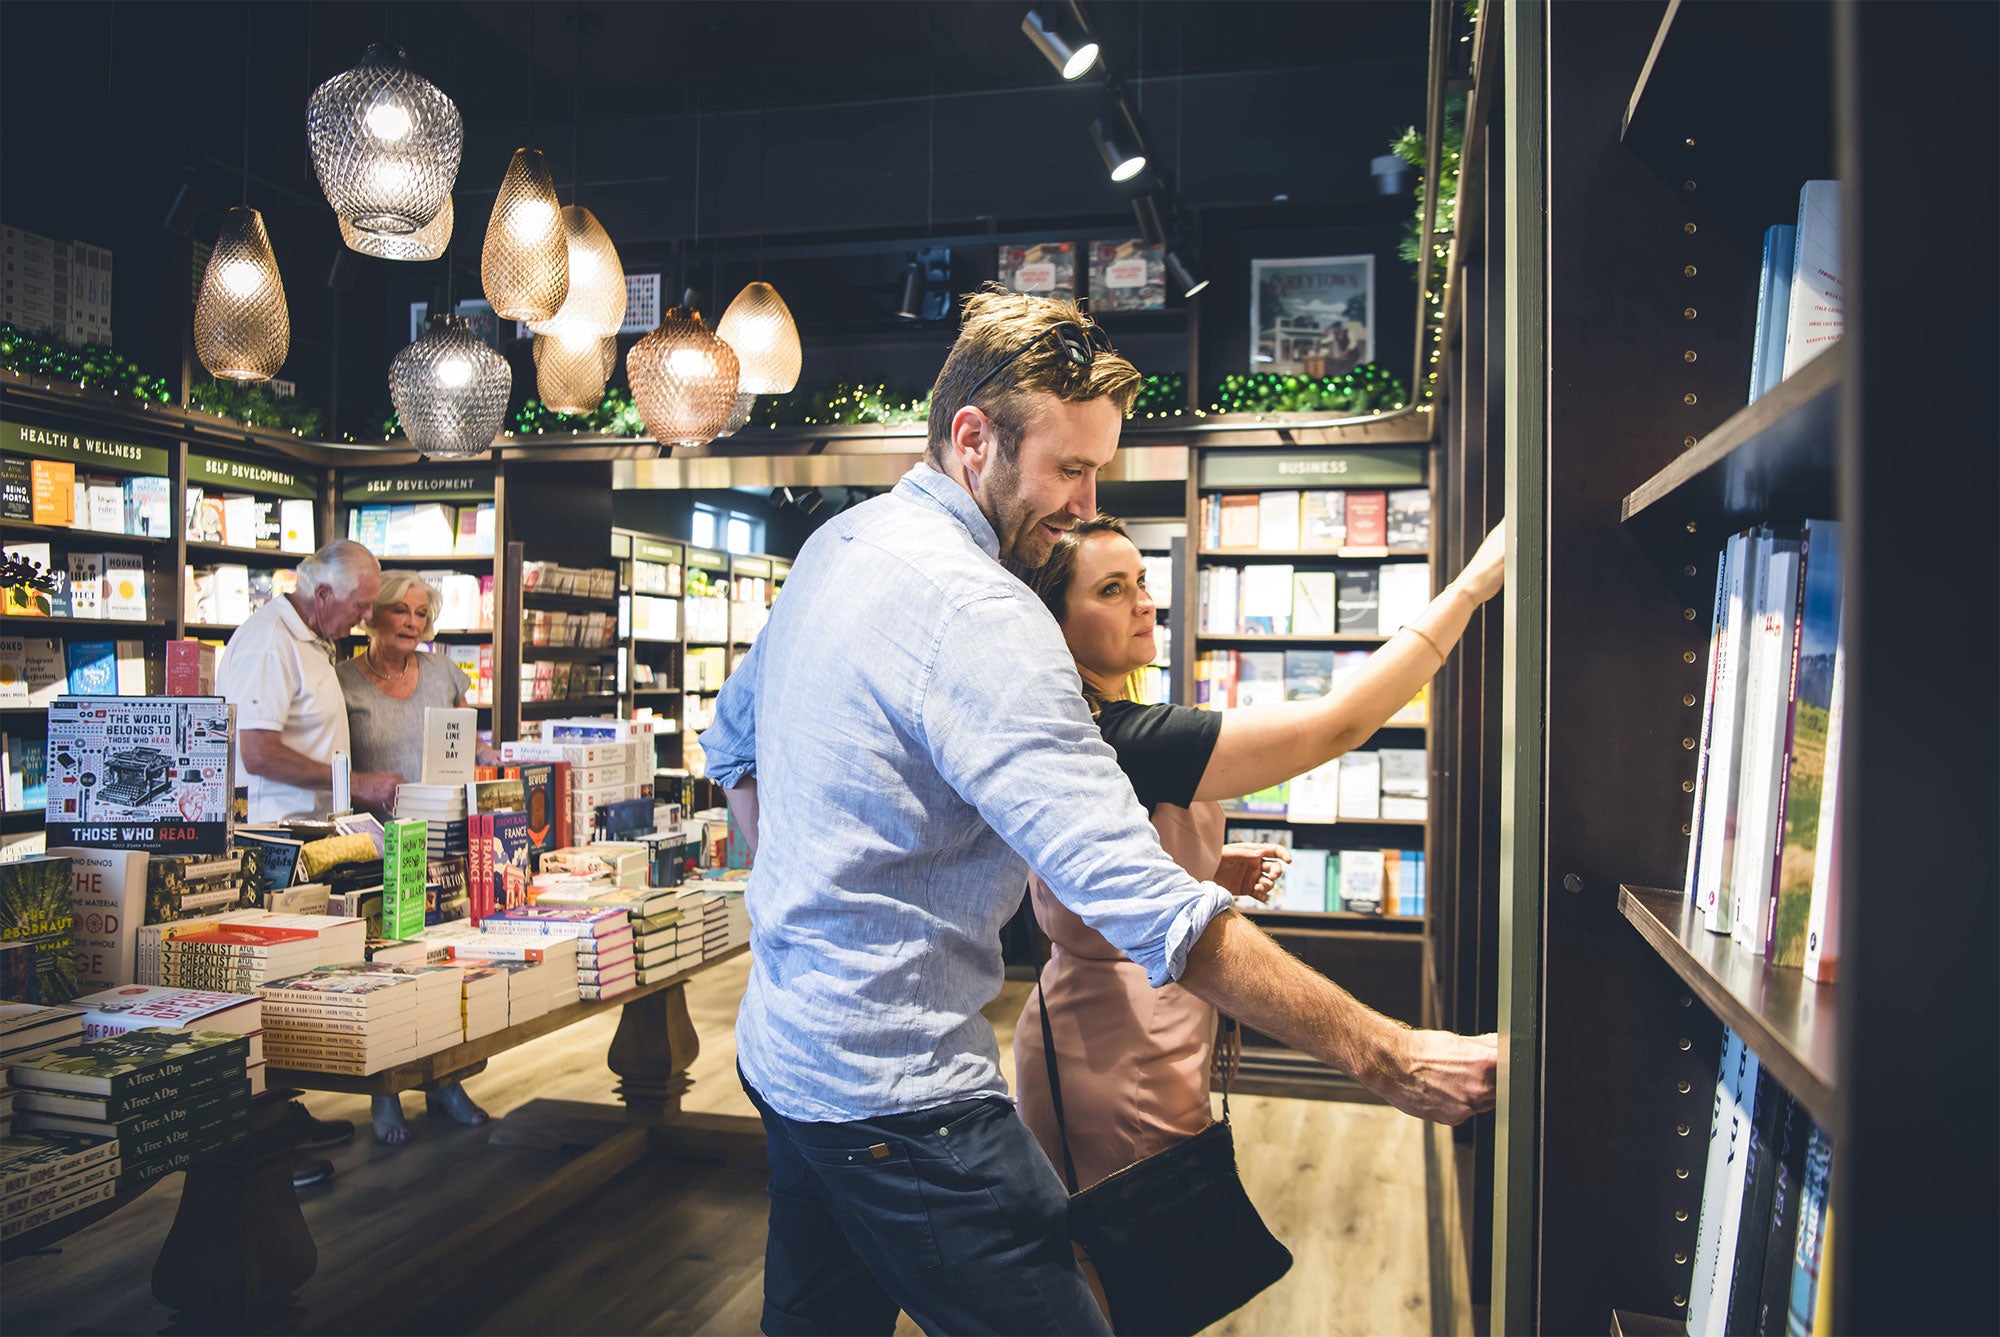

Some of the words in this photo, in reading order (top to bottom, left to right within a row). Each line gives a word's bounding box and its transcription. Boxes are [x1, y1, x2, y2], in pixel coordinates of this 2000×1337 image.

[20, 427, 68, 448] HEALTH
[72, 437, 81, 450] &
[86, 439, 142, 460] WELLNESS
[205, 460, 229, 475] SELF
[231, 464, 294, 486] DEVELOPMENT
[1278, 460, 1348, 474] BUSINESS
[5, 484, 27, 495] BEING
[367, 480, 393, 492] SELF
[396, 478, 475, 491] DEVELOPMENT
[2, 492, 31, 504] MORTAL
[109, 557, 143, 569] HOOKED
[109, 714, 130, 724] THE
[133, 714, 171, 724] WORLD
[106, 725, 154, 735] BELONGS
[157, 725, 171, 735] TO
[446, 722, 460, 731] ONE
[108, 736, 130, 744] THOSE
[133, 736, 149, 744] WHO
[445, 732, 460, 740] LINE
[450, 741, 455, 750] A
[445, 751, 458, 759] DAY
[528, 773, 548, 786] SEWERS
[72, 828, 118, 841] THOSE
[121, 828, 154, 841] WHO
[159, 828, 199, 840] READ.
[504, 826, 527, 839] FRANCE
[402, 840, 417, 852] HOW
[419, 838, 425, 851] TO
[87, 859, 113, 867] ENNOS
[402, 854, 420, 869] SPEND
[470, 838, 480, 882] FRANCE
[483, 838, 493, 883] FRANCE
[402, 871, 424, 885] TRILLION
[84, 900, 118, 908] MATERIAL
[3, 917, 73, 940] RBORNAUT
[73, 913, 119, 934] OOD
[91, 940, 115, 949] WHOLE
[181, 942, 233, 956] CHECKLIST
[239, 945, 254, 953] ATUL
[75, 954, 103, 974] GE
[179, 954, 231, 968] CHECKLIST
[237, 957, 253, 965] ATUL
[179, 966, 230, 979] CHECKLIST
[236, 969, 252, 977] ATUL
[178, 977, 229, 990] CHECKLIST
[236, 980, 252, 989] ATUL
[128, 991, 212, 1017] EMPIRE
[153, 1008, 183, 1020] OF
[87, 1023, 100, 1038] OF
[126, 1077, 135, 1088] A
[135, 1072, 155, 1086] Tree
[157, 1068, 166, 1079] A
[166, 1063, 184, 1076] Day
[1709, 1024, 1730, 1141] RADA
[121, 1101, 130, 1112] A
[130, 1097, 150, 1110] Tree
[152, 1092, 161, 1102] A
[161, 1087, 179, 1100] Day
[131, 1124, 141, 1135] A
[141, 1119, 160, 1132] Tree
[162, 1114, 171, 1124] A
[170, 1108, 188, 1121] Day
[1744, 1066, 1767, 1193] HANEL
[134, 1146, 143, 1157] A
[142, 1141, 162, 1154] Tree
[165, 1135, 173, 1146] A
[172, 1130, 190, 1143] Day
[30, 1164, 57, 1185] HOME
[60, 1159, 82, 1172] MARK
[84, 1149, 105, 1163] BOYLE
[1772, 1091, 1796, 1232] HANEL
